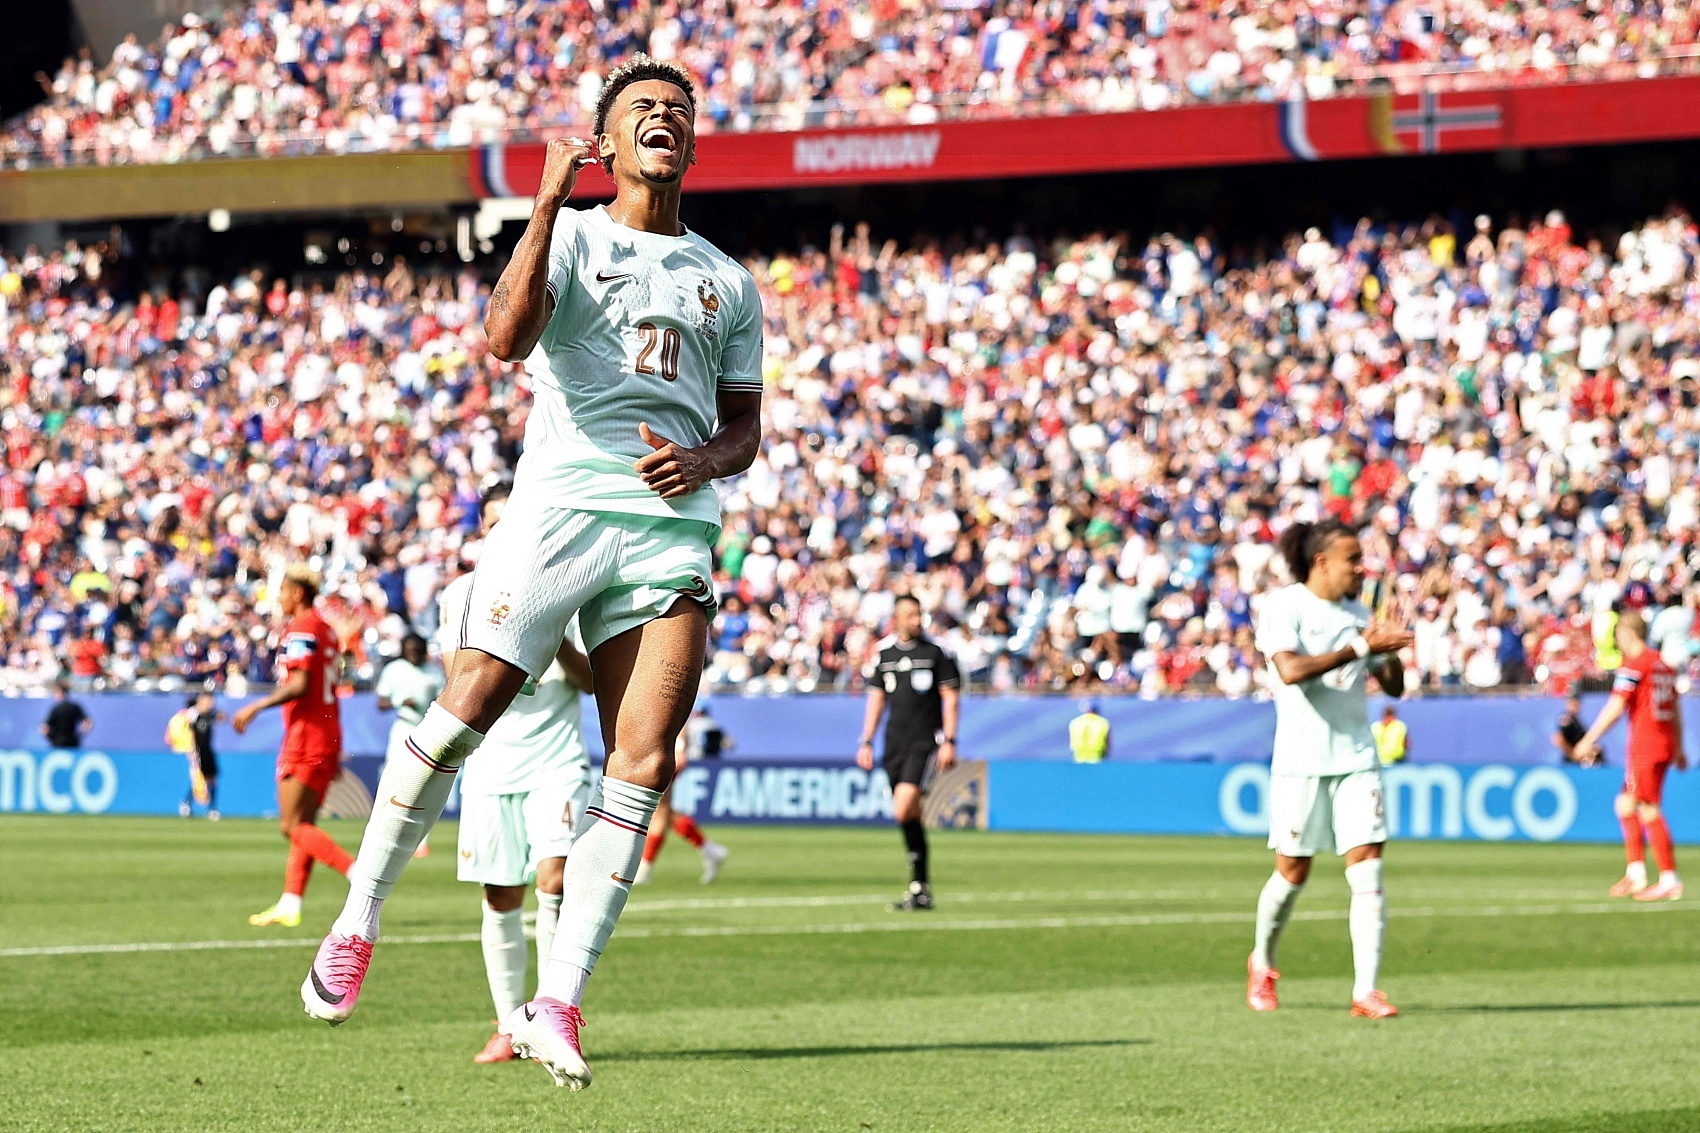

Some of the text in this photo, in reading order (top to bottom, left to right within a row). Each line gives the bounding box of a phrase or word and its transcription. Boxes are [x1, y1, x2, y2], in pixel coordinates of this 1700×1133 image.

[793, 132, 941, 172] NORWAY
[635, 322, 682, 381] 20
[561, 800, 575, 831] 4
[710, 766, 898, 820] AMERICA
[1219, 762, 1578, 842] amco
